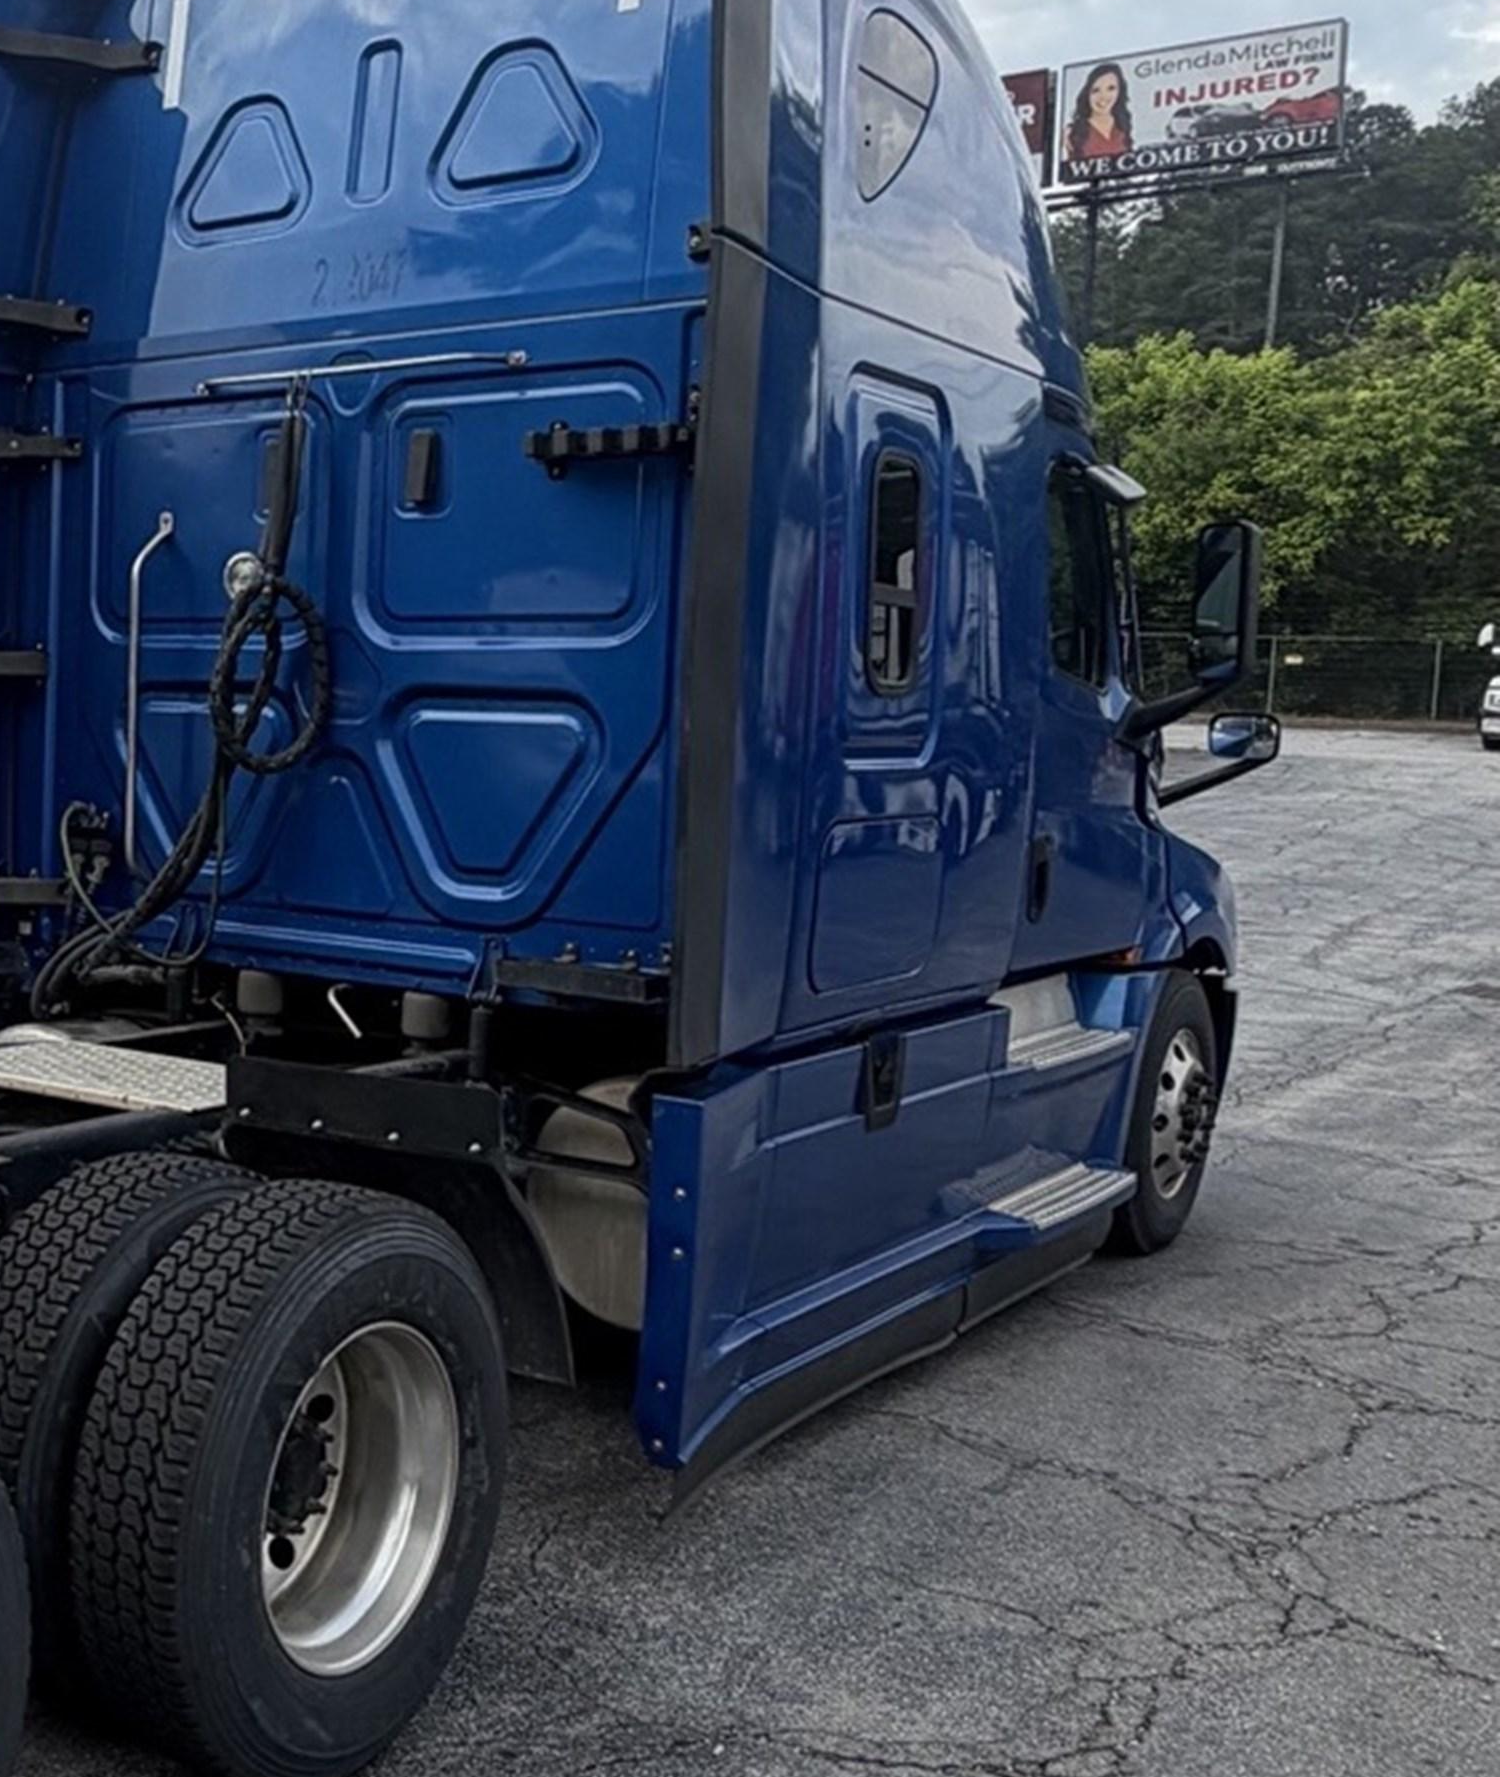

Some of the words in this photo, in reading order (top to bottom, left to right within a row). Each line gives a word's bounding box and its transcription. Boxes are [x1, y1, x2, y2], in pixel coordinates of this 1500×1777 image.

[1253, 56, 1290, 72] LAW
[1293, 50, 1335, 66] FIRM
[1153, 66, 1320, 108] INJURED?
[1068, 157, 1111, 177] WE
[1116, 143, 1200, 171] COME
[1206, 137, 1248, 159] TO
[1254, 126, 1328, 153] YOU!
